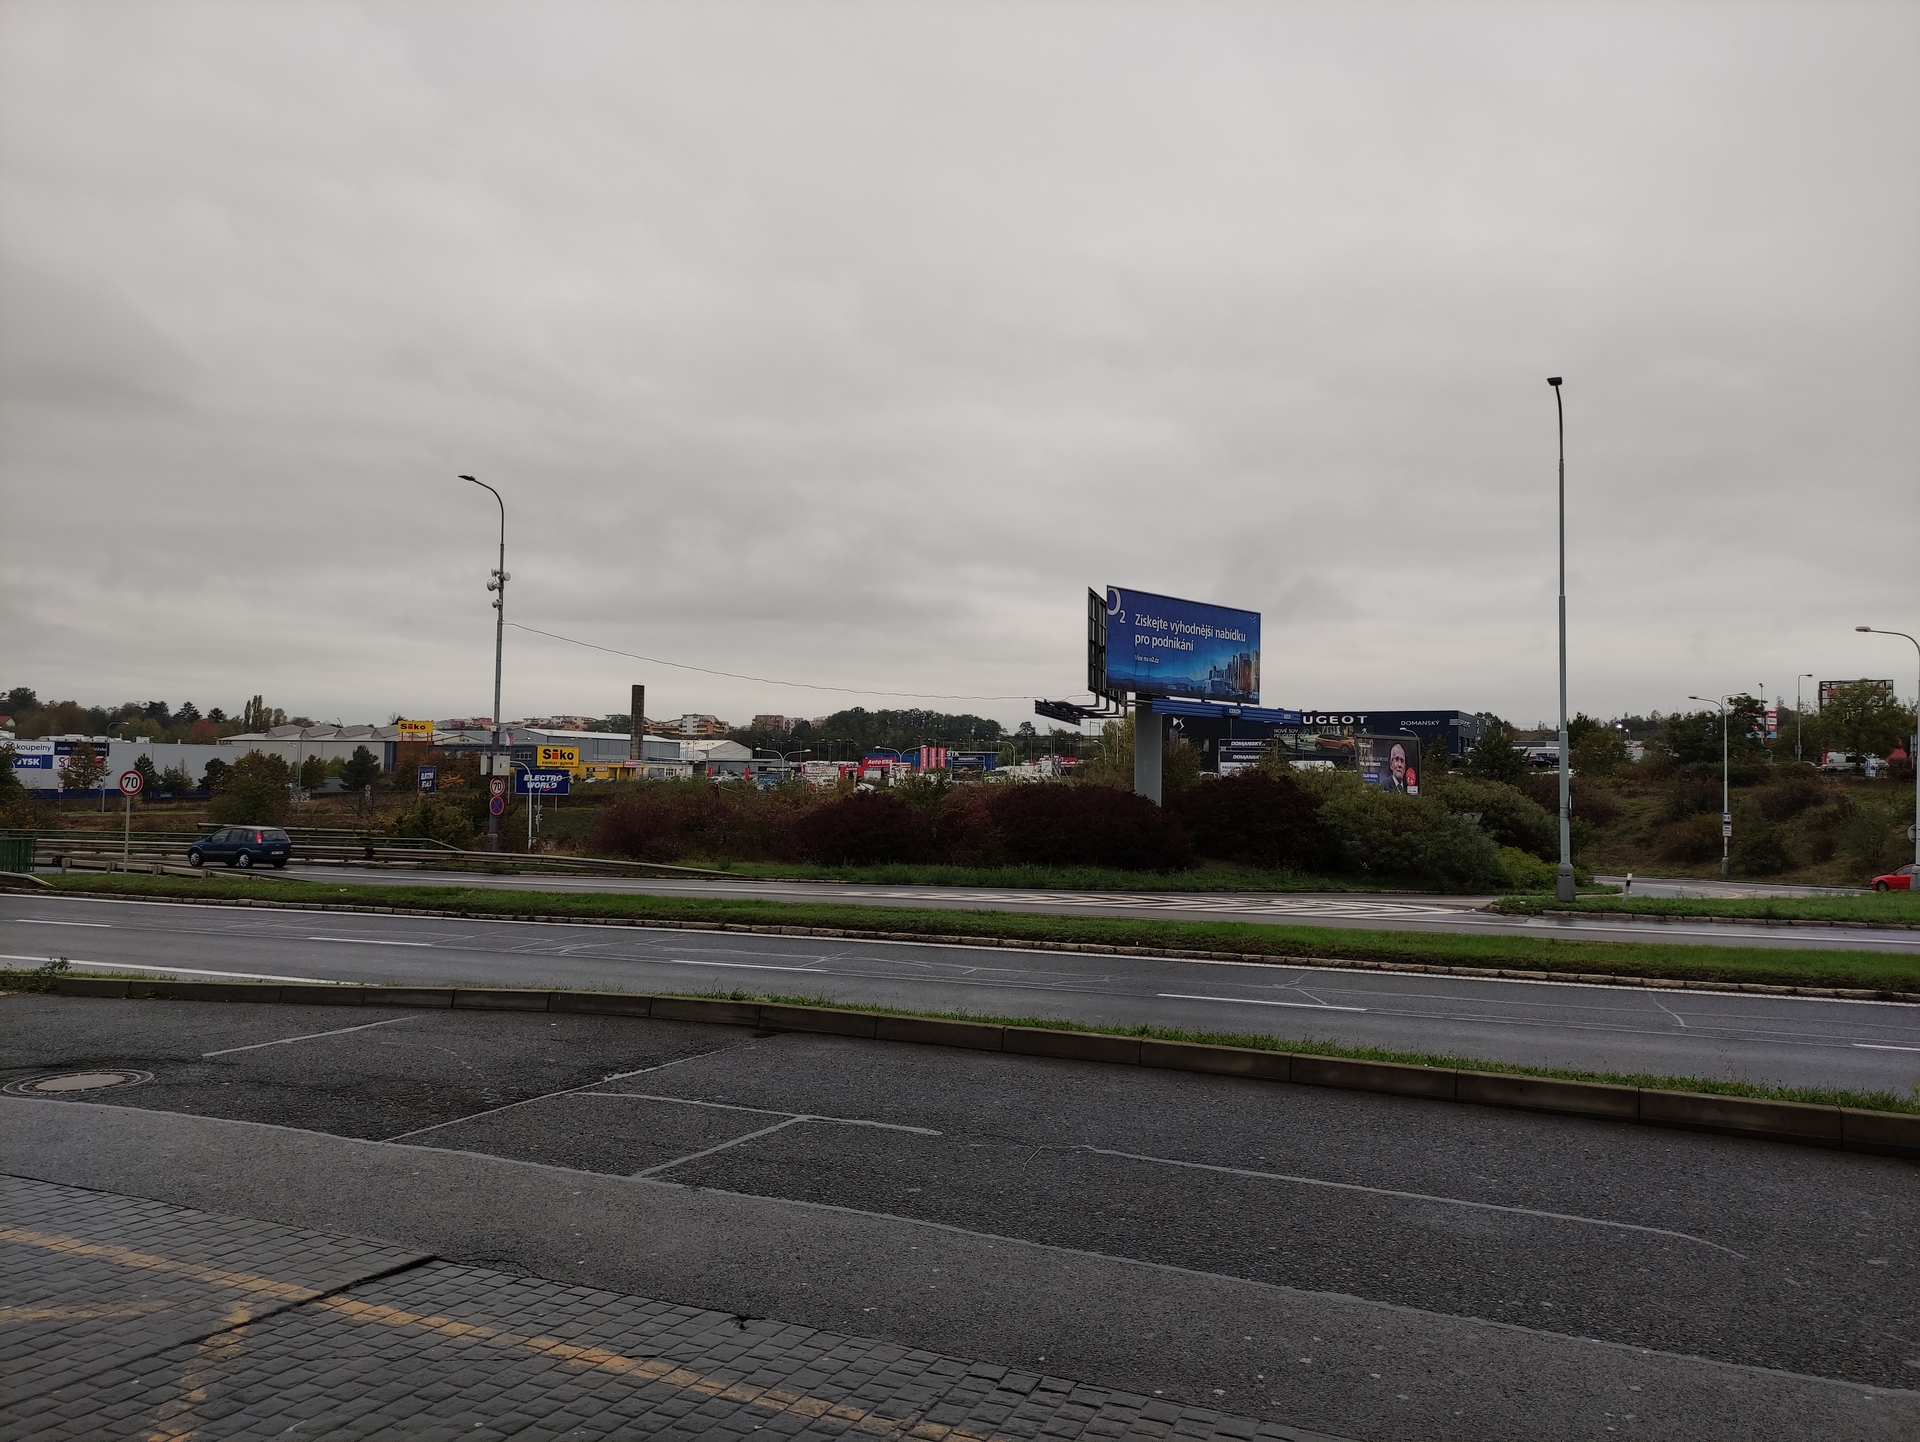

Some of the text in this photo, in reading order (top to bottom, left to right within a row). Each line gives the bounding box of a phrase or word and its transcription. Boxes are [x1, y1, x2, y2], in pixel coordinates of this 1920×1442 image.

[1135, 614, 1246, 643] Získejte výhodnější nabídku
[1134, 634, 1194, 651] pro podnikání
[1302, 715, 1368, 725] UGEOT
[16, 743, 52, 753] koupelny
[542, 748, 575, 761] Siko
[124, 777, 138, 789] 70
[523, 774, 564, 782] ELECTRO
[493, 782, 502, 792] 70
[527, 781, 558, 789] WORLD
